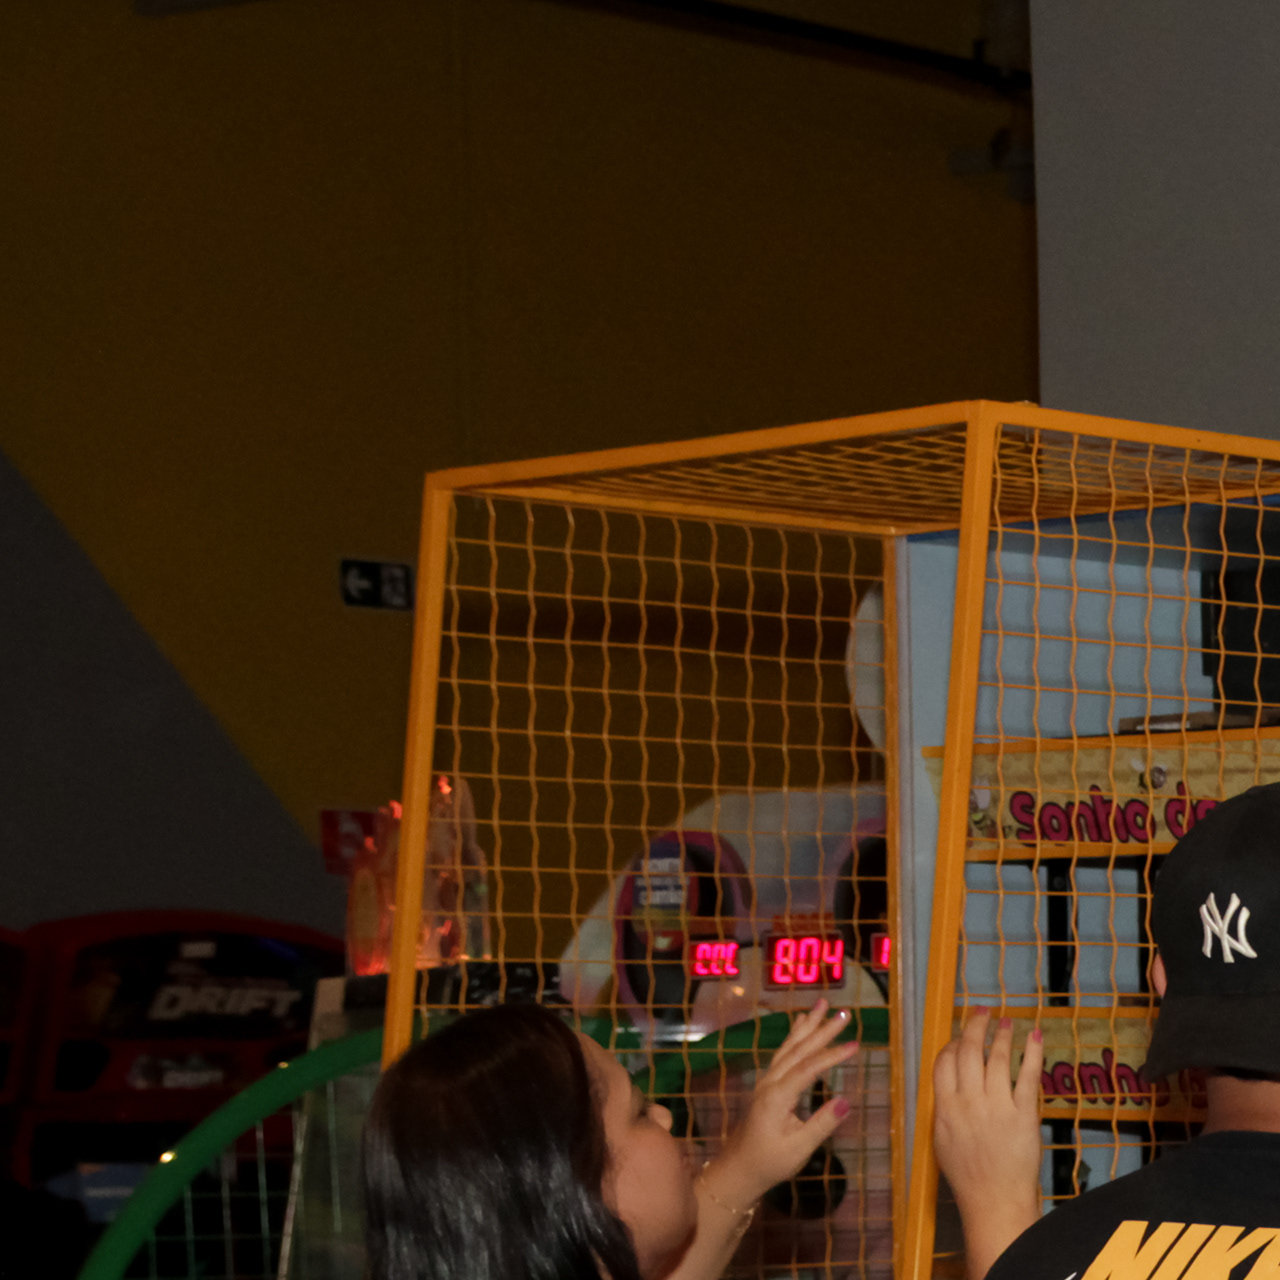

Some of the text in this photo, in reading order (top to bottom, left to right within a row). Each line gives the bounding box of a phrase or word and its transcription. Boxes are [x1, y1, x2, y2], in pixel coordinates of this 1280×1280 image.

[1010, 785, 1156, 846] Sonho
[1200, 893, 1258, 964] NY
[1041, 1048, 1170, 1107] onho
